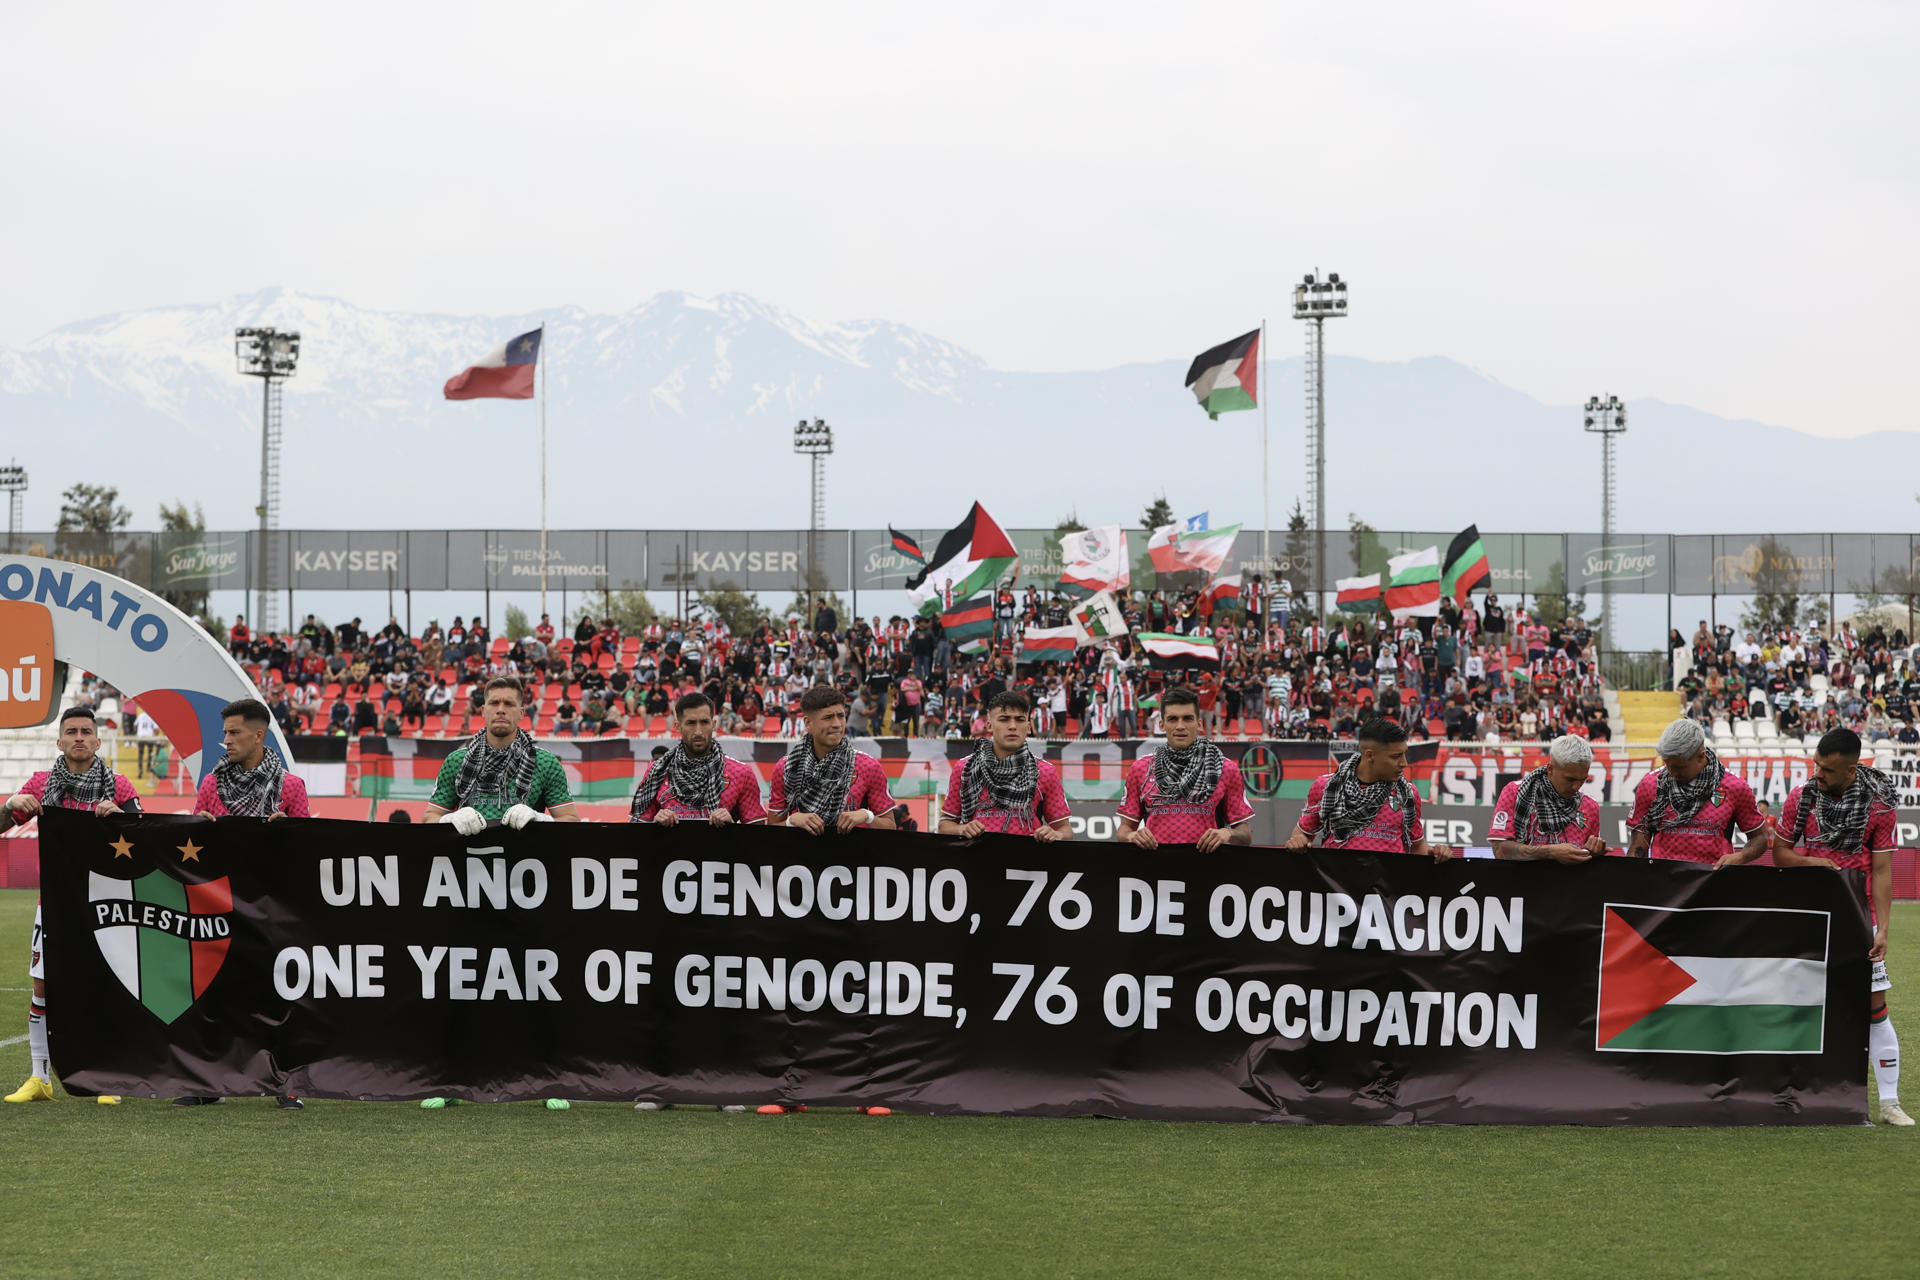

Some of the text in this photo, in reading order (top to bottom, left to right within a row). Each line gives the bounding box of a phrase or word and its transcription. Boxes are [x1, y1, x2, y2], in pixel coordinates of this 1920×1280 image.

[166, 551, 237, 576] San Jorge
[294, 550, 398, 572] KAYSER
[692, 551, 798, 572] KAYSER
[864, 553, 896, 573] San
[1582, 552, 1656, 576] San Jorge
[1769, 556, 1837, 570] MARLEY
[320, 846, 1524, 953] UN AÑO DE GENOCIDIO, 76 DE OCUPACIÓN
[96, 903, 230, 939] PALESTINO
[274, 944, 1538, 1050] ONE YEAR OF GENOCIDE, 76 OF OCCUPATION
